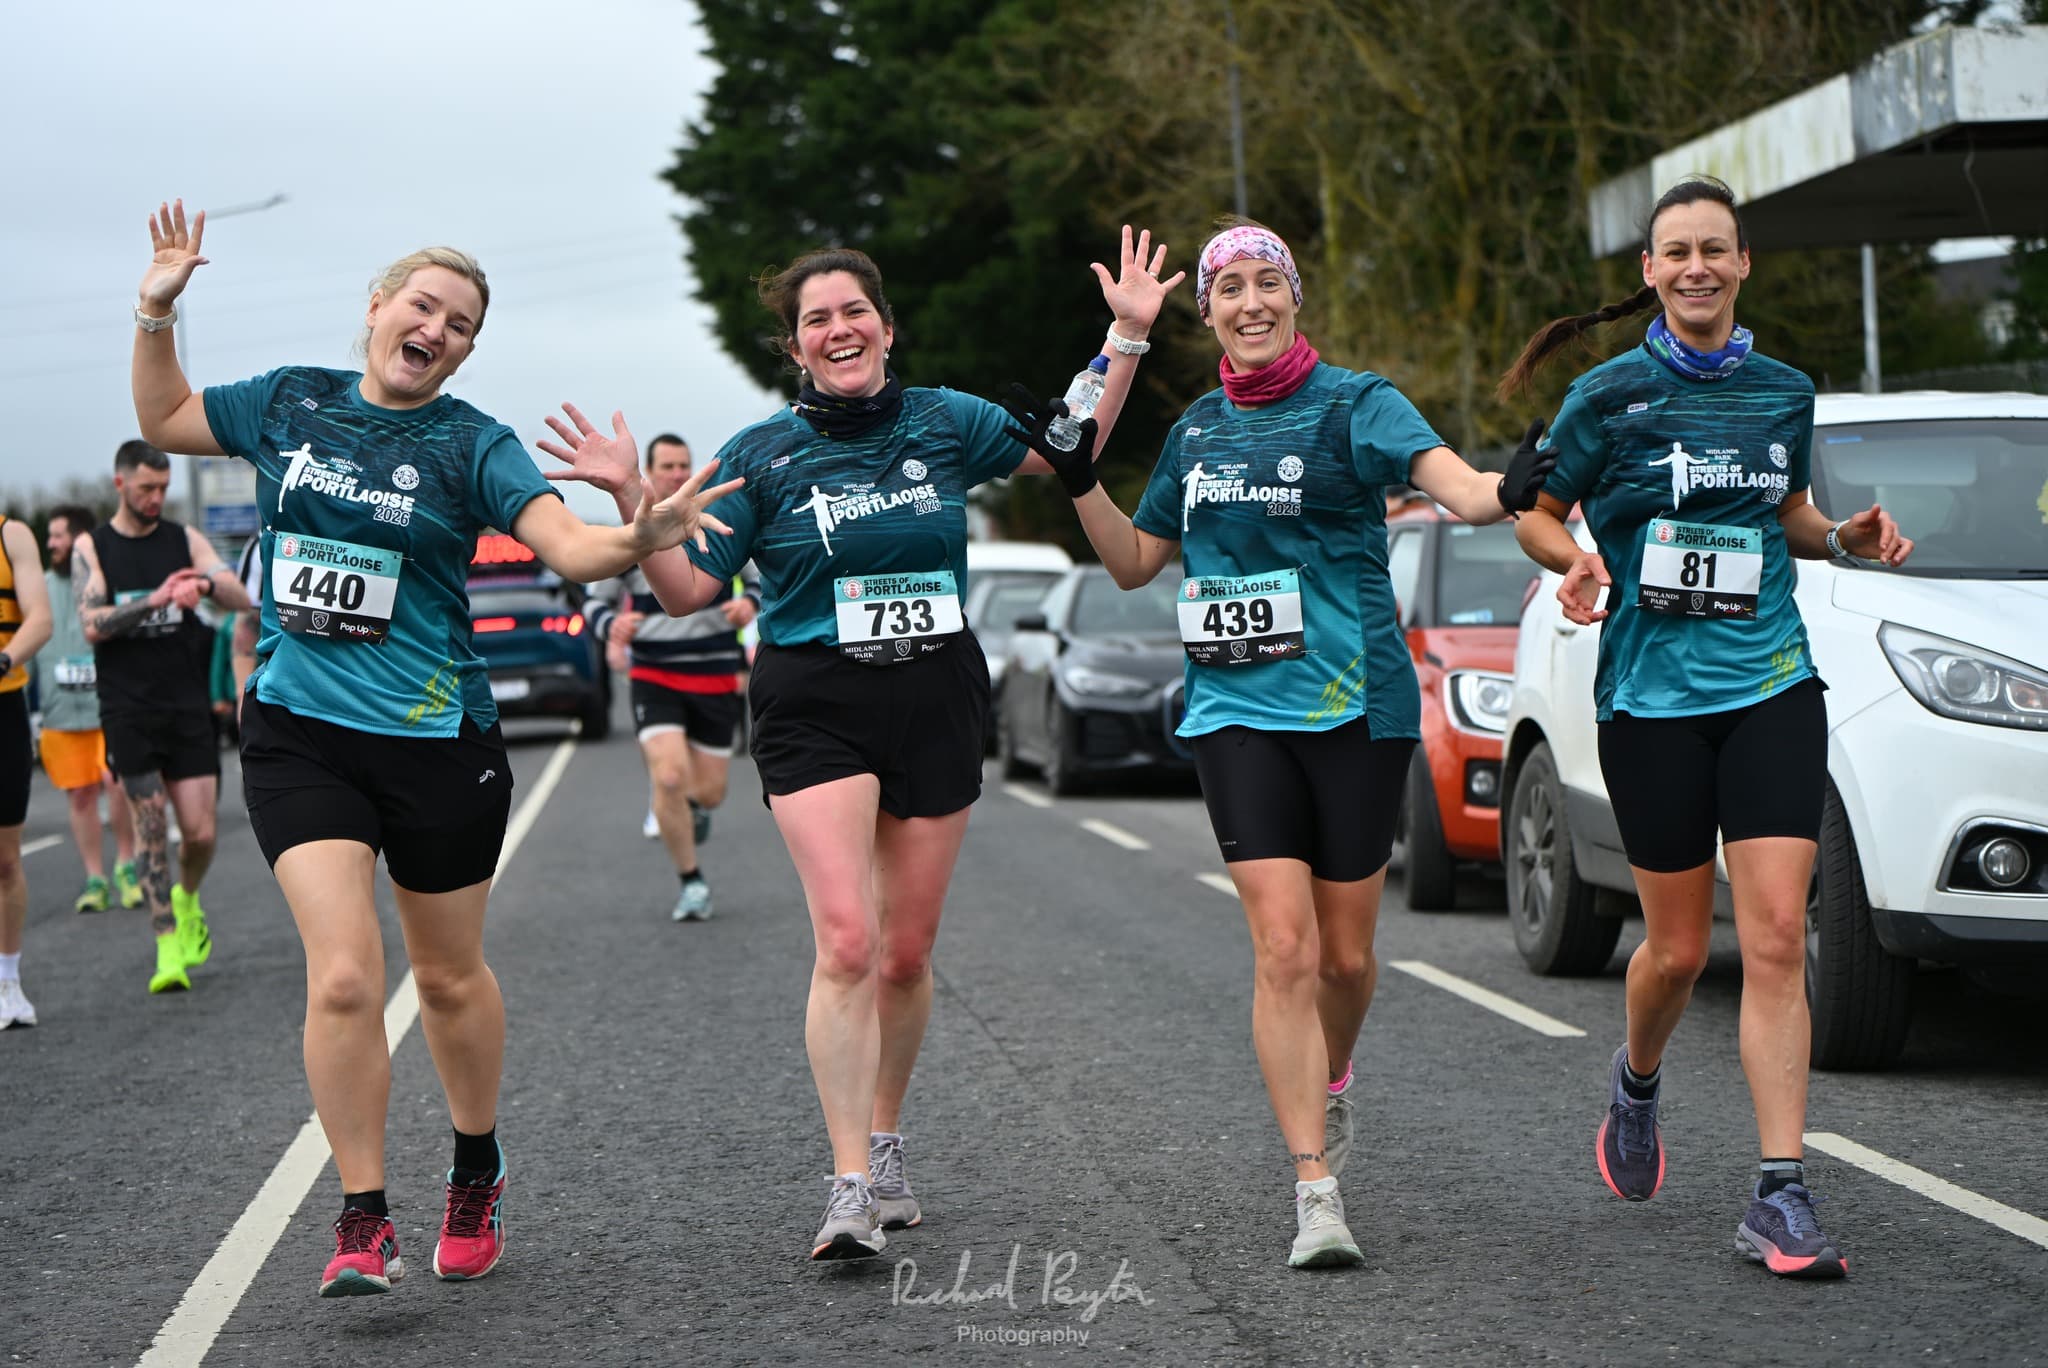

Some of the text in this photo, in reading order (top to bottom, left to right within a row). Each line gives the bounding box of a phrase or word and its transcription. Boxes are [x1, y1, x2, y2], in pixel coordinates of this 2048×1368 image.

[303, 466, 359, 485] STREETS OF
[1688, 464, 1742, 473] STREETS OF
[1198, 478, 1245, 489] STREETS OF
[1690, 473, 1789, 490] PORTLAOISE
[298, 474, 415, 512] PORTLAOISE
[1196, 486, 1303, 503] PORTLAOISE
[829, 492, 881, 512] STREETS OF
[831, 484, 938, 525] PORTLAOISE
[1267, 502, 1301, 517] 2026
[373, 505, 411, 527] 2026
[1676, 526, 1715, 536] STREETS OF
[300, 540, 348, 554] STREETS OF
[1675, 533, 1748, 549] PORTLAOISE
[299, 548, 383, 572] PORTLAOISE
[1680, 551, 1717, 588] 81
[289, 566, 366, 611] 440
[864, 576, 909, 586] STREETS OF
[865, 581, 941, 596] PORTLAOISE
[1201, 580, 1281, 597] PORTLAOISE
[1235, 578, 1245, 586] OF
[1643, 590, 1680, 601] MIDLANDS
[1650, 598, 1669, 607] PARK
[1714, 601, 1742, 613] Pop Up
[864, 599, 935, 637] 733
[1203, 598, 1274, 637] 439
[340, 622, 369, 635] Pop Up
[845, 644, 882, 653] MIDLANDS
[921, 644, 935, 652] Pop
[1259, 643, 1287, 655] Pop Up
